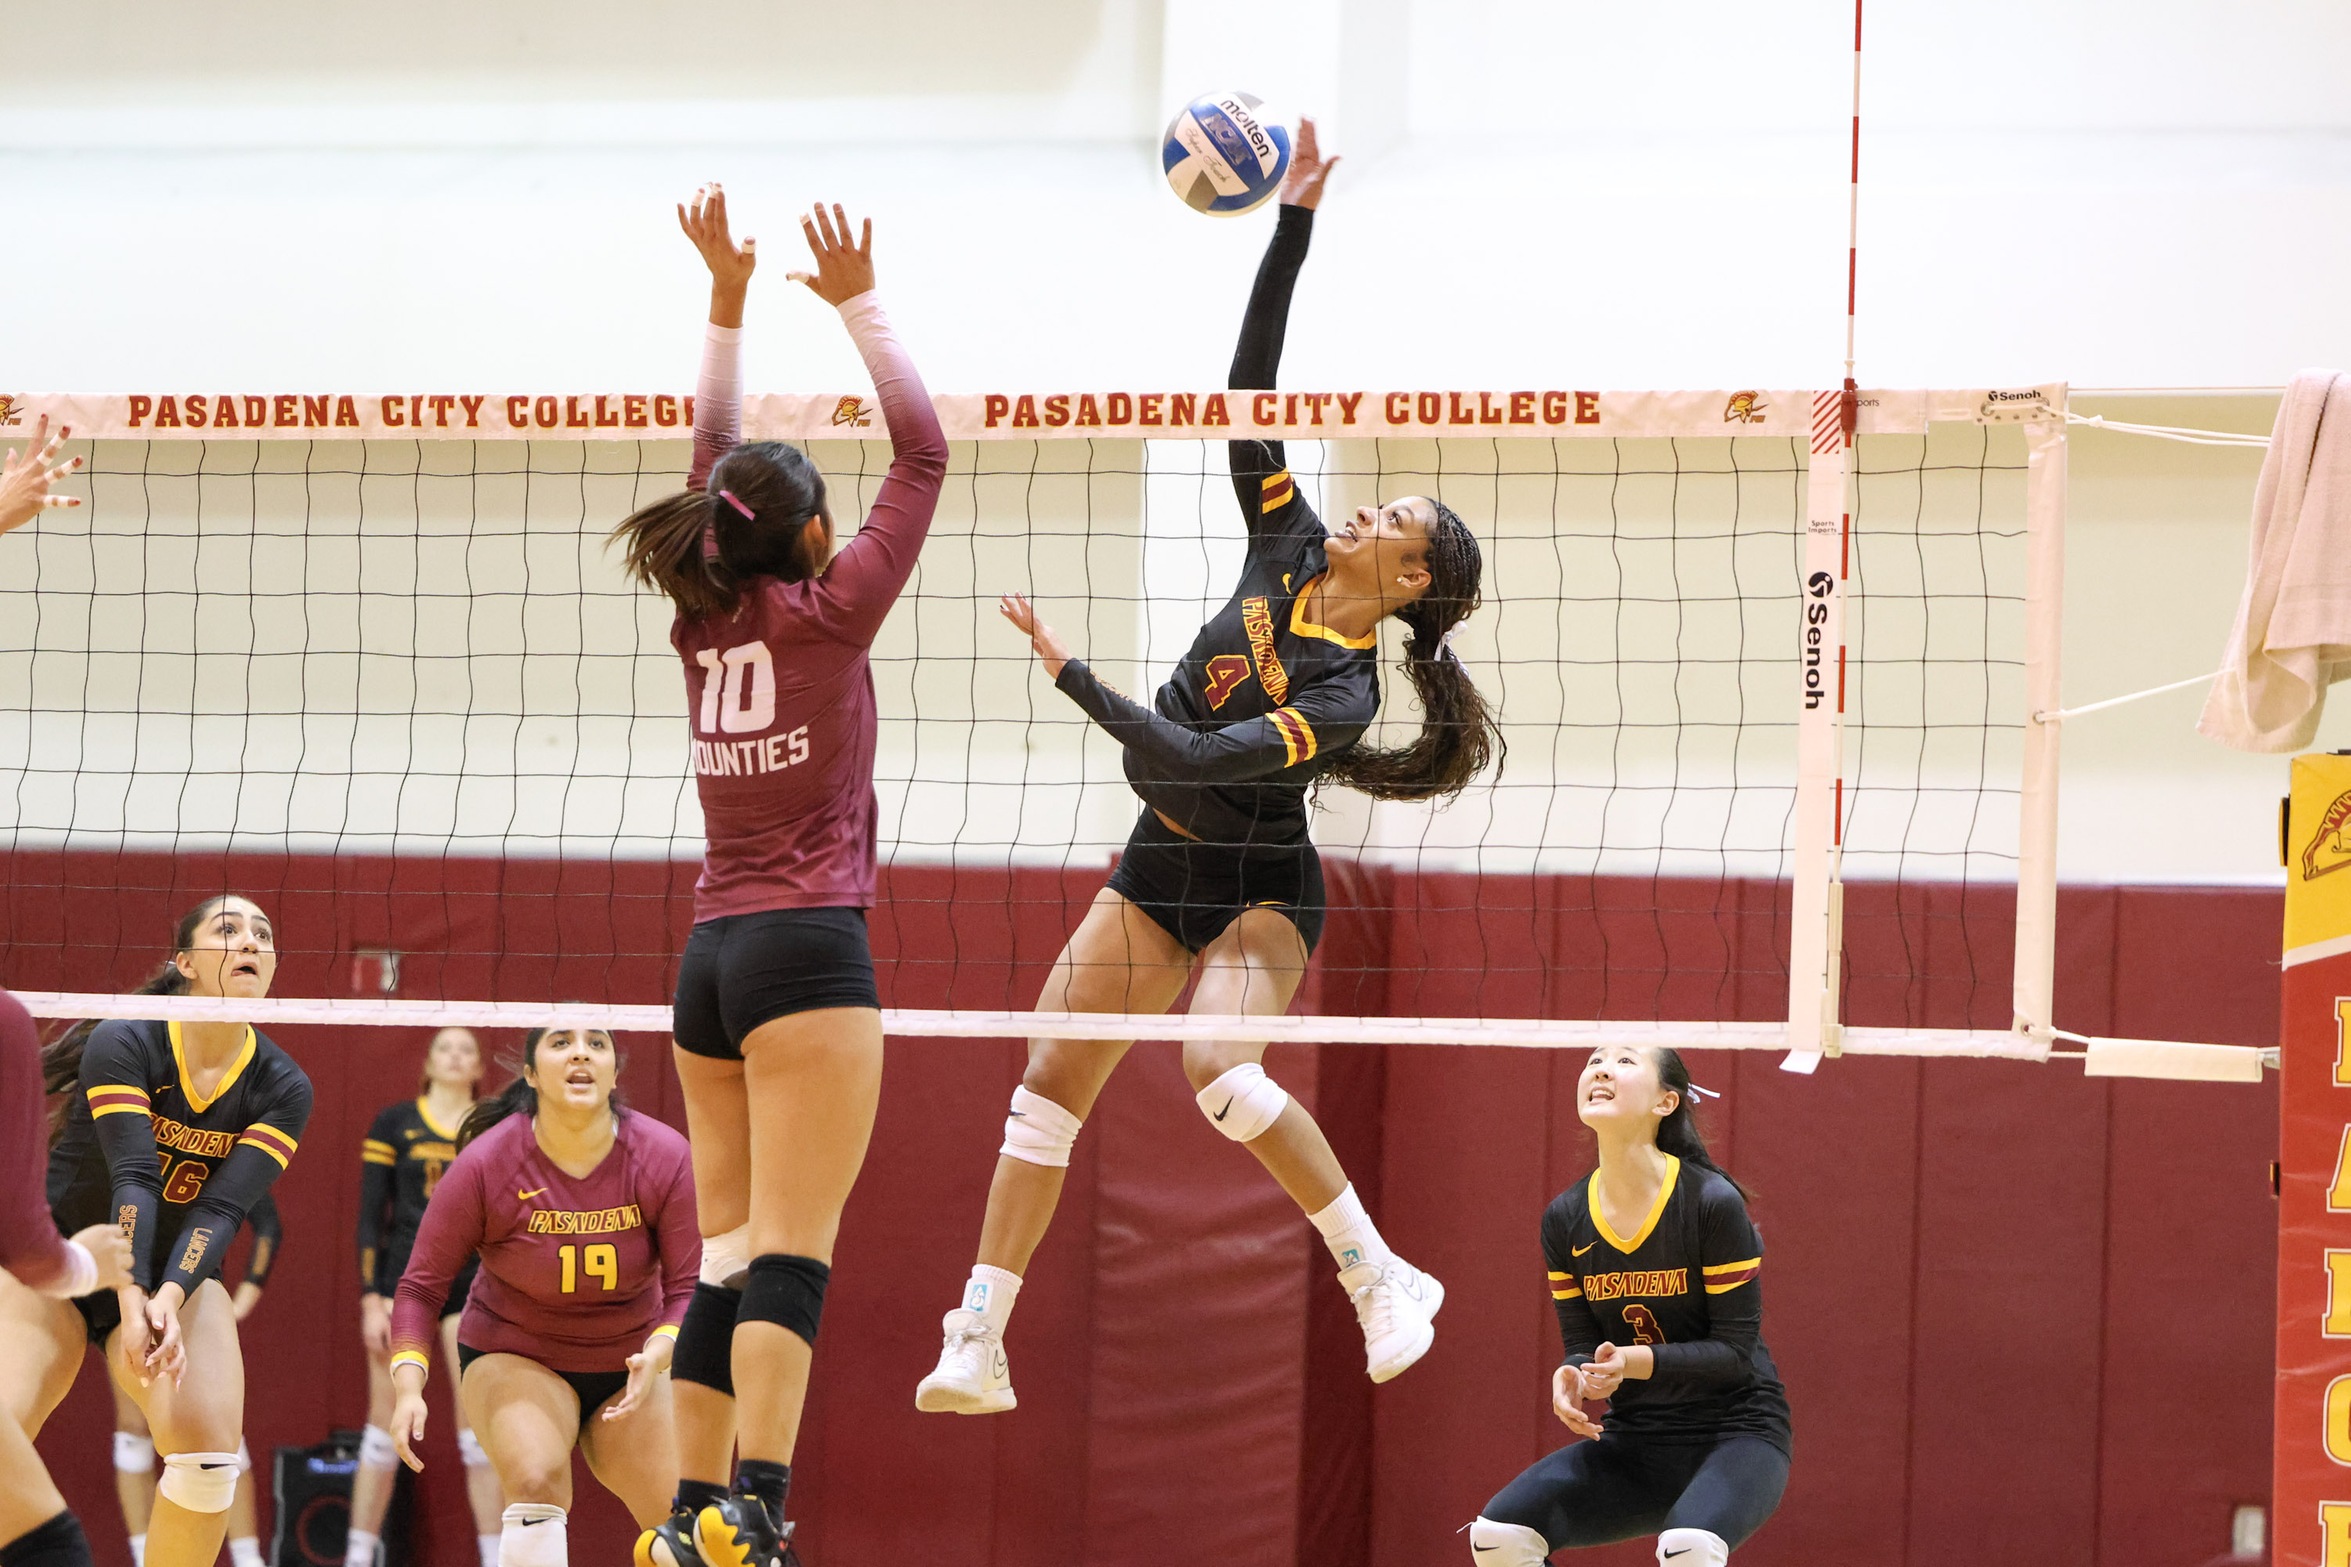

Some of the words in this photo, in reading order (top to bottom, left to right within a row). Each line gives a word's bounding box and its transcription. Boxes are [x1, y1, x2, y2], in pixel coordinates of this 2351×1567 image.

[1220, 99, 1270, 158] molten
[128, 394, 360, 428] PASADENA
[381, 395, 484, 427] CITY
[984, 392, 1230, 428] PASADENA
[1252, 392, 1363, 426] CITY
[1385, 391, 1601, 425] COLLEGE
[1999, 389, 2041, 401] Senoh
[1811, 519, 1835, 528] Sports
[1805, 603, 1828, 709] Senoh
[696, 640, 776, 733] 10
[1205, 654, 1252, 711] 4
[692, 725, 809, 776] OUNTIES
[151, 1112, 240, 1158] ASADEN
[527, 1204, 642, 1234] PASADENA
[558, 1243, 618, 1294] 19
[1583, 1267, 1688, 1301] PASADENA
[1622, 1304, 1667, 1346] 3
